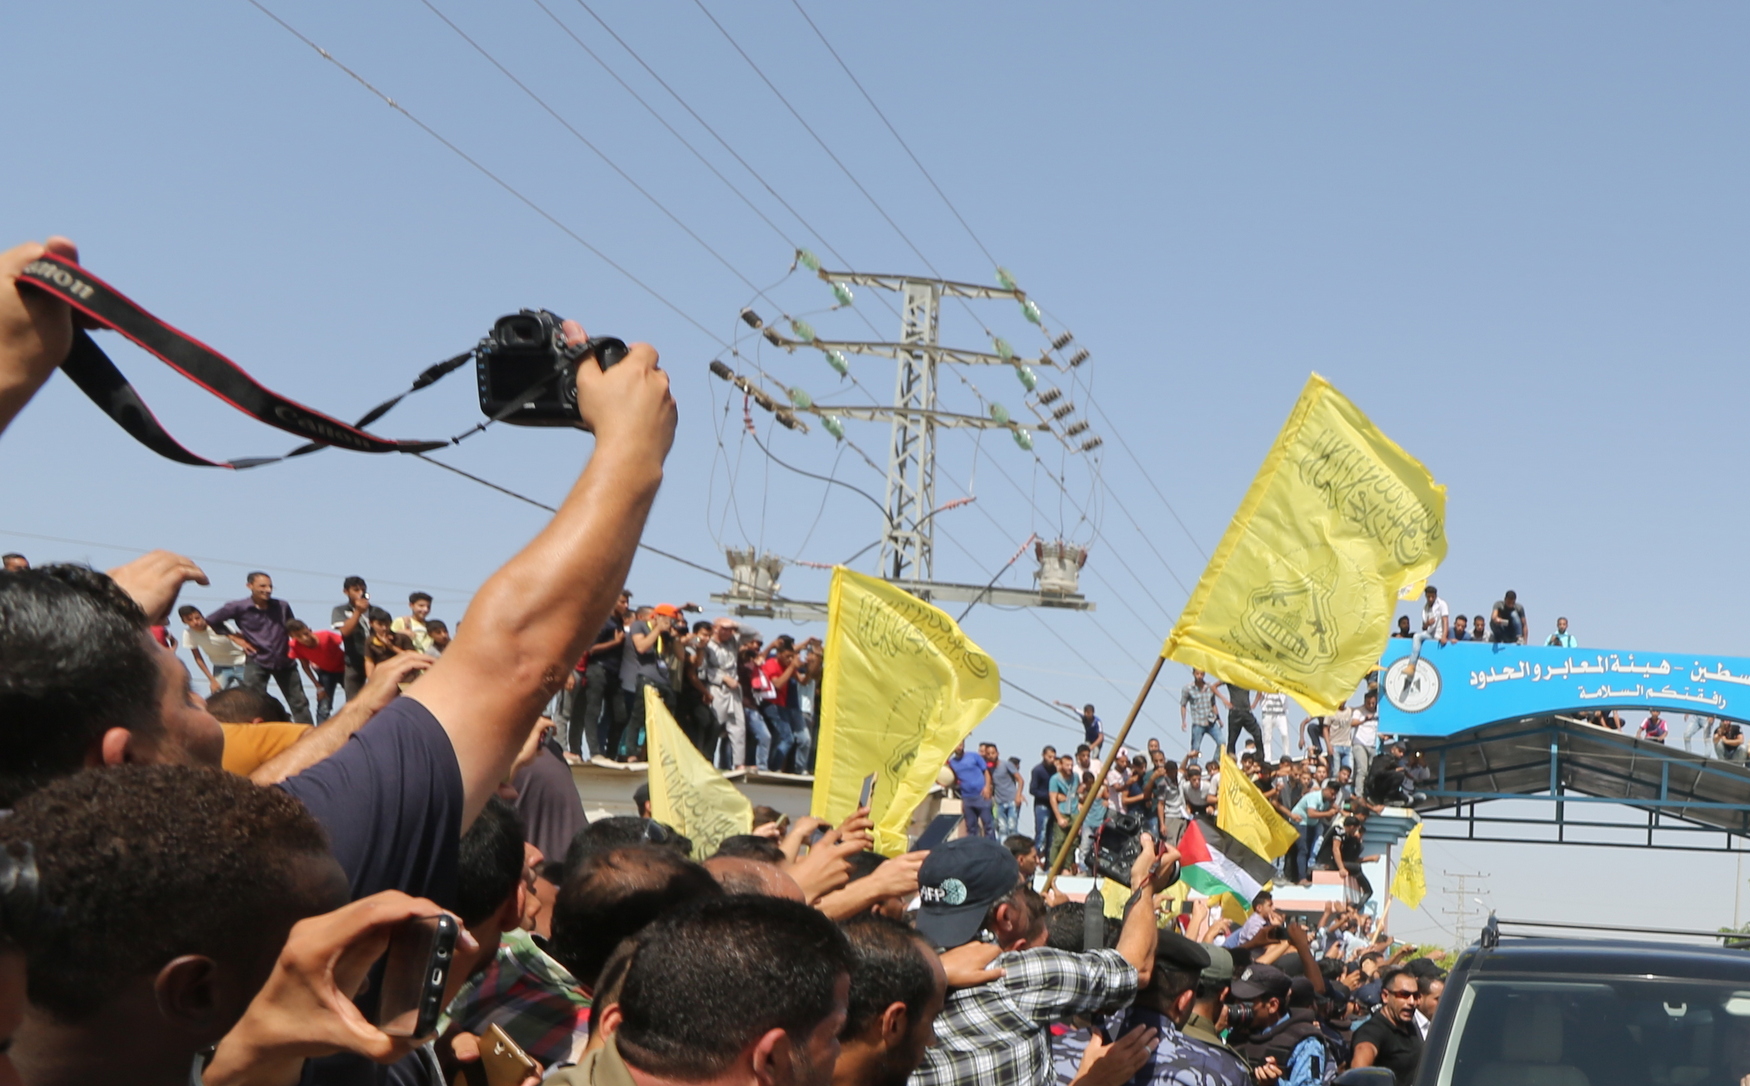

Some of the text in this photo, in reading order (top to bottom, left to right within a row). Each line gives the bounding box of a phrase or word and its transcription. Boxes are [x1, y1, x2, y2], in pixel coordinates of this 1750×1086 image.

[22, 261, 95, 299] anon
[1543, 655, 1609, 680] المعابر
[1610, 653, 1671, 679] هيئة
[1577, 683, 1727, 710] رافقتكم السلامة
[920, 885, 946, 902] AFP
